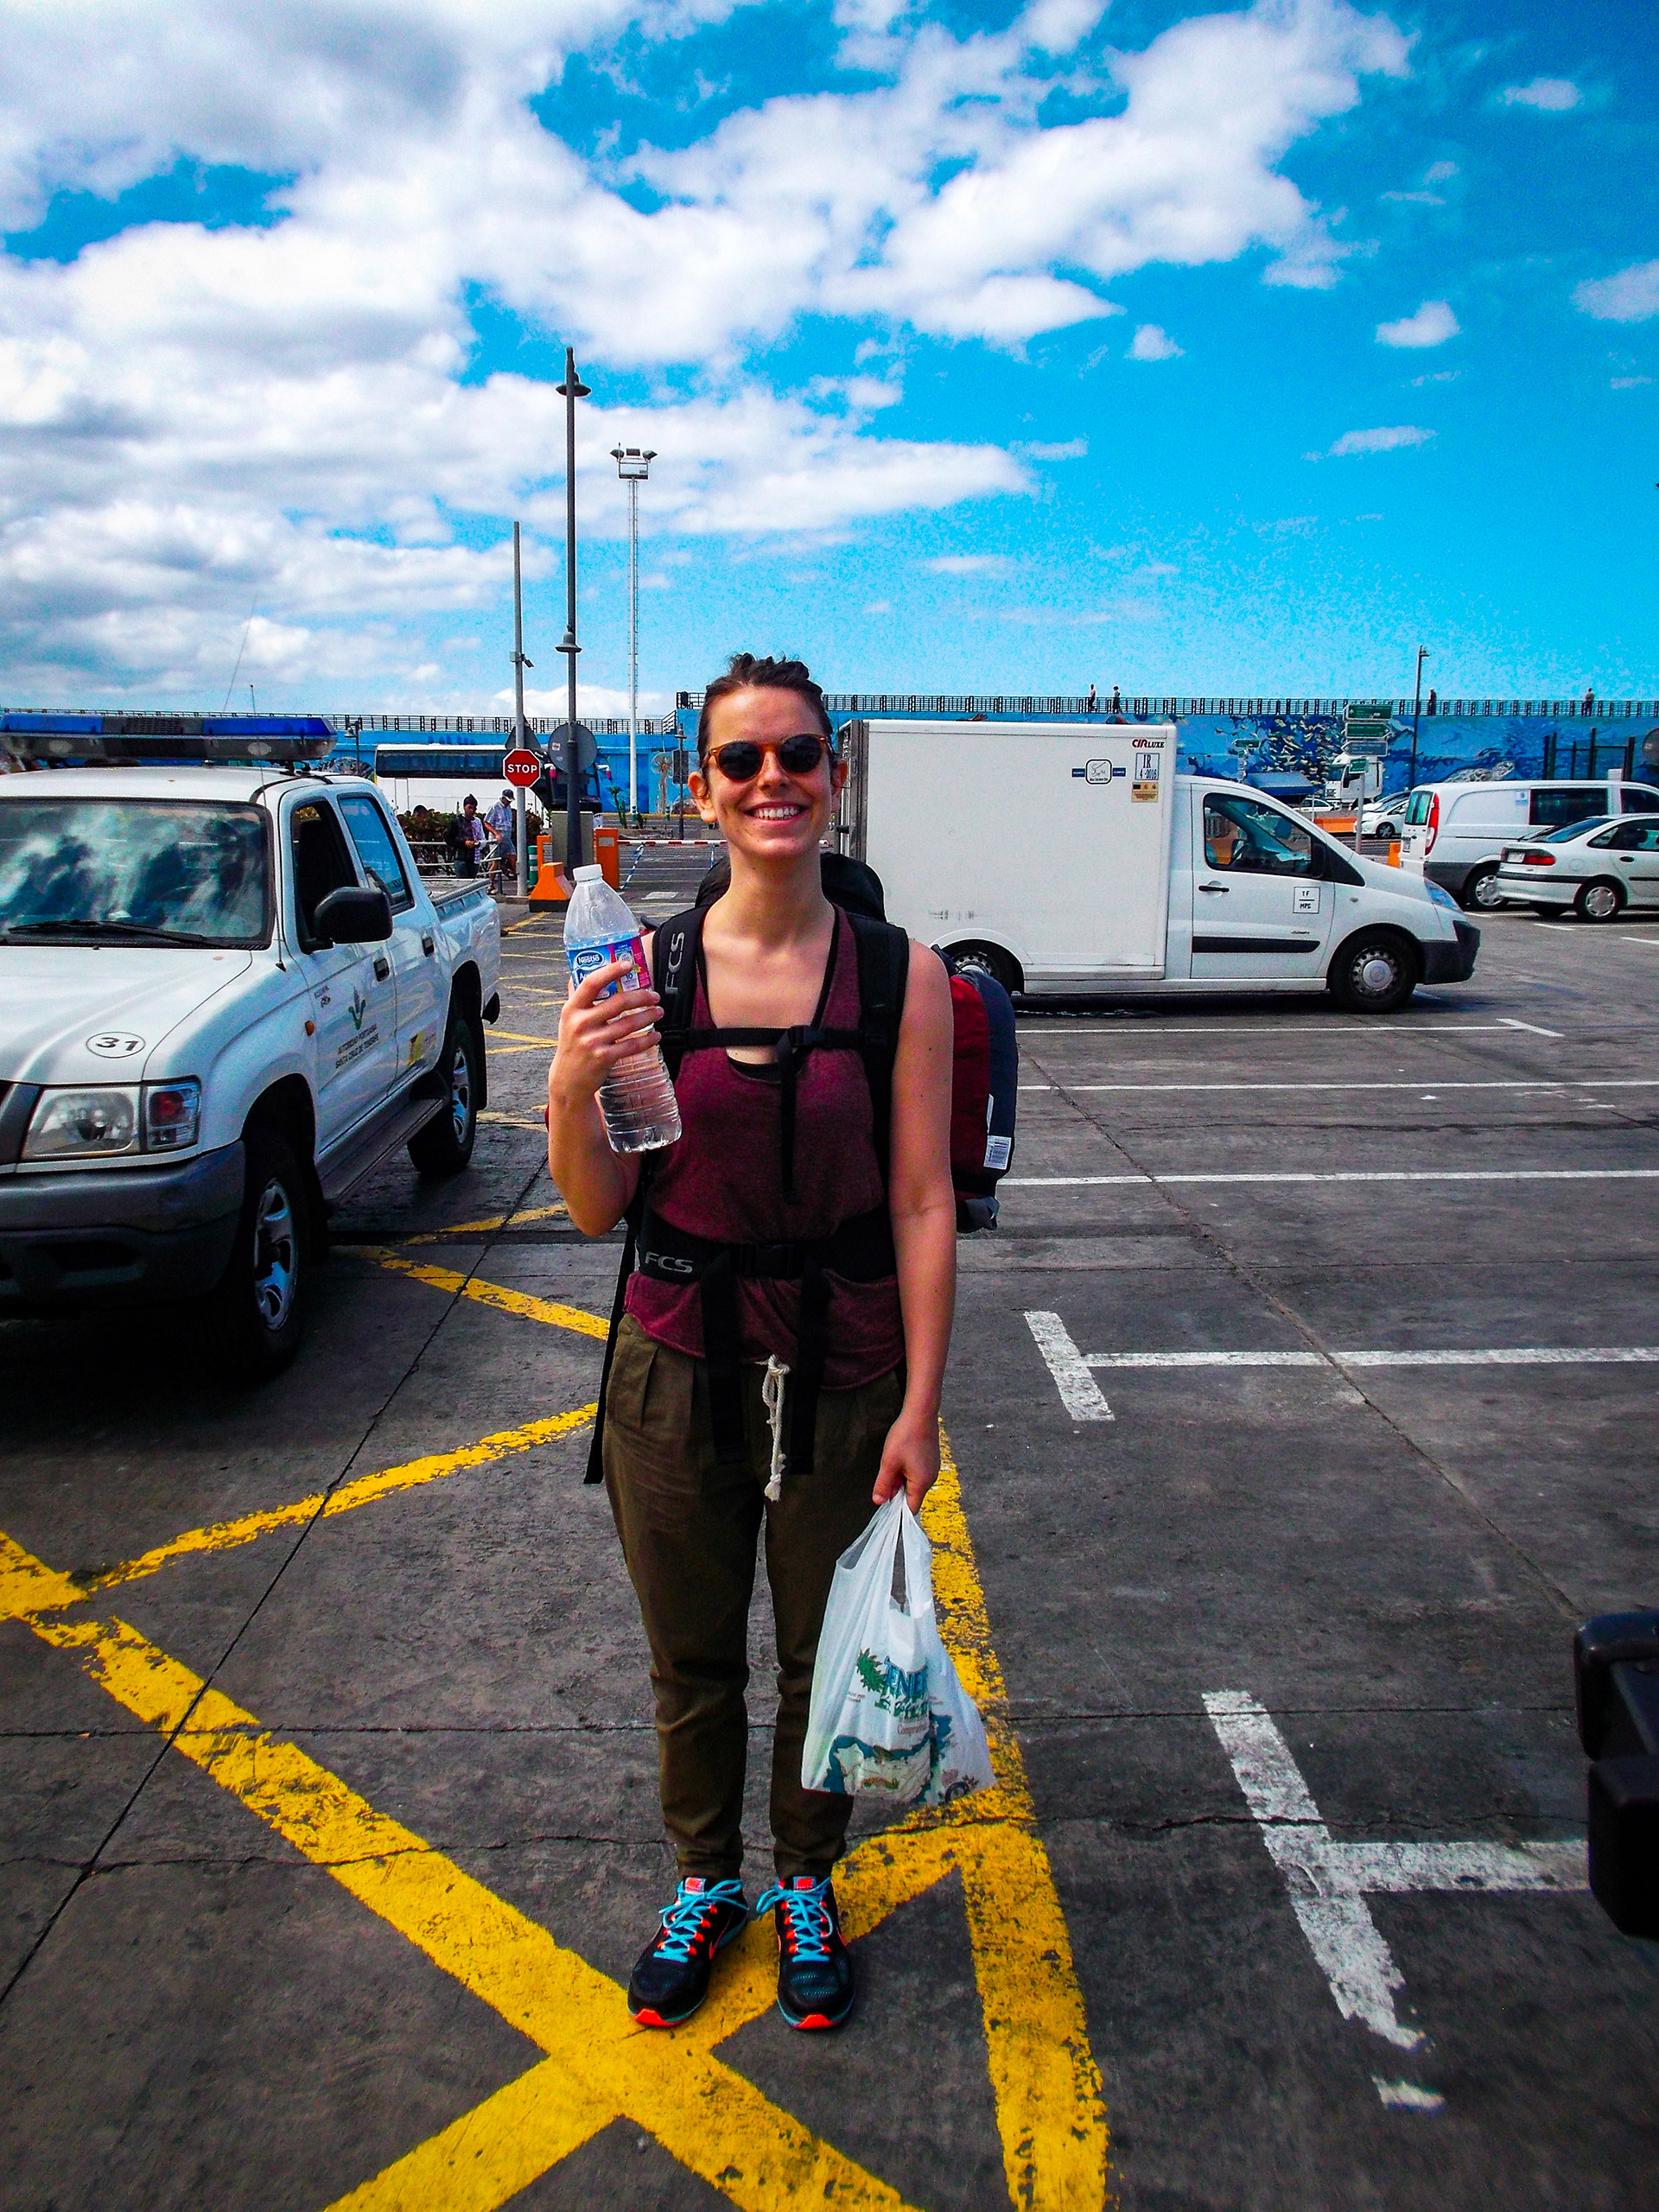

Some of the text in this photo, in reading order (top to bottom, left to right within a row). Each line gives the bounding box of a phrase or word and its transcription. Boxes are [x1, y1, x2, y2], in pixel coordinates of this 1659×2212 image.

[507, 764, 537, 773] STOP
[1143, 754, 1152, 768] IR
[664, 931, 685, 995] FCS
[96, 1037, 139, 1052] 31
[645, 1251, 693, 1274] FCS
